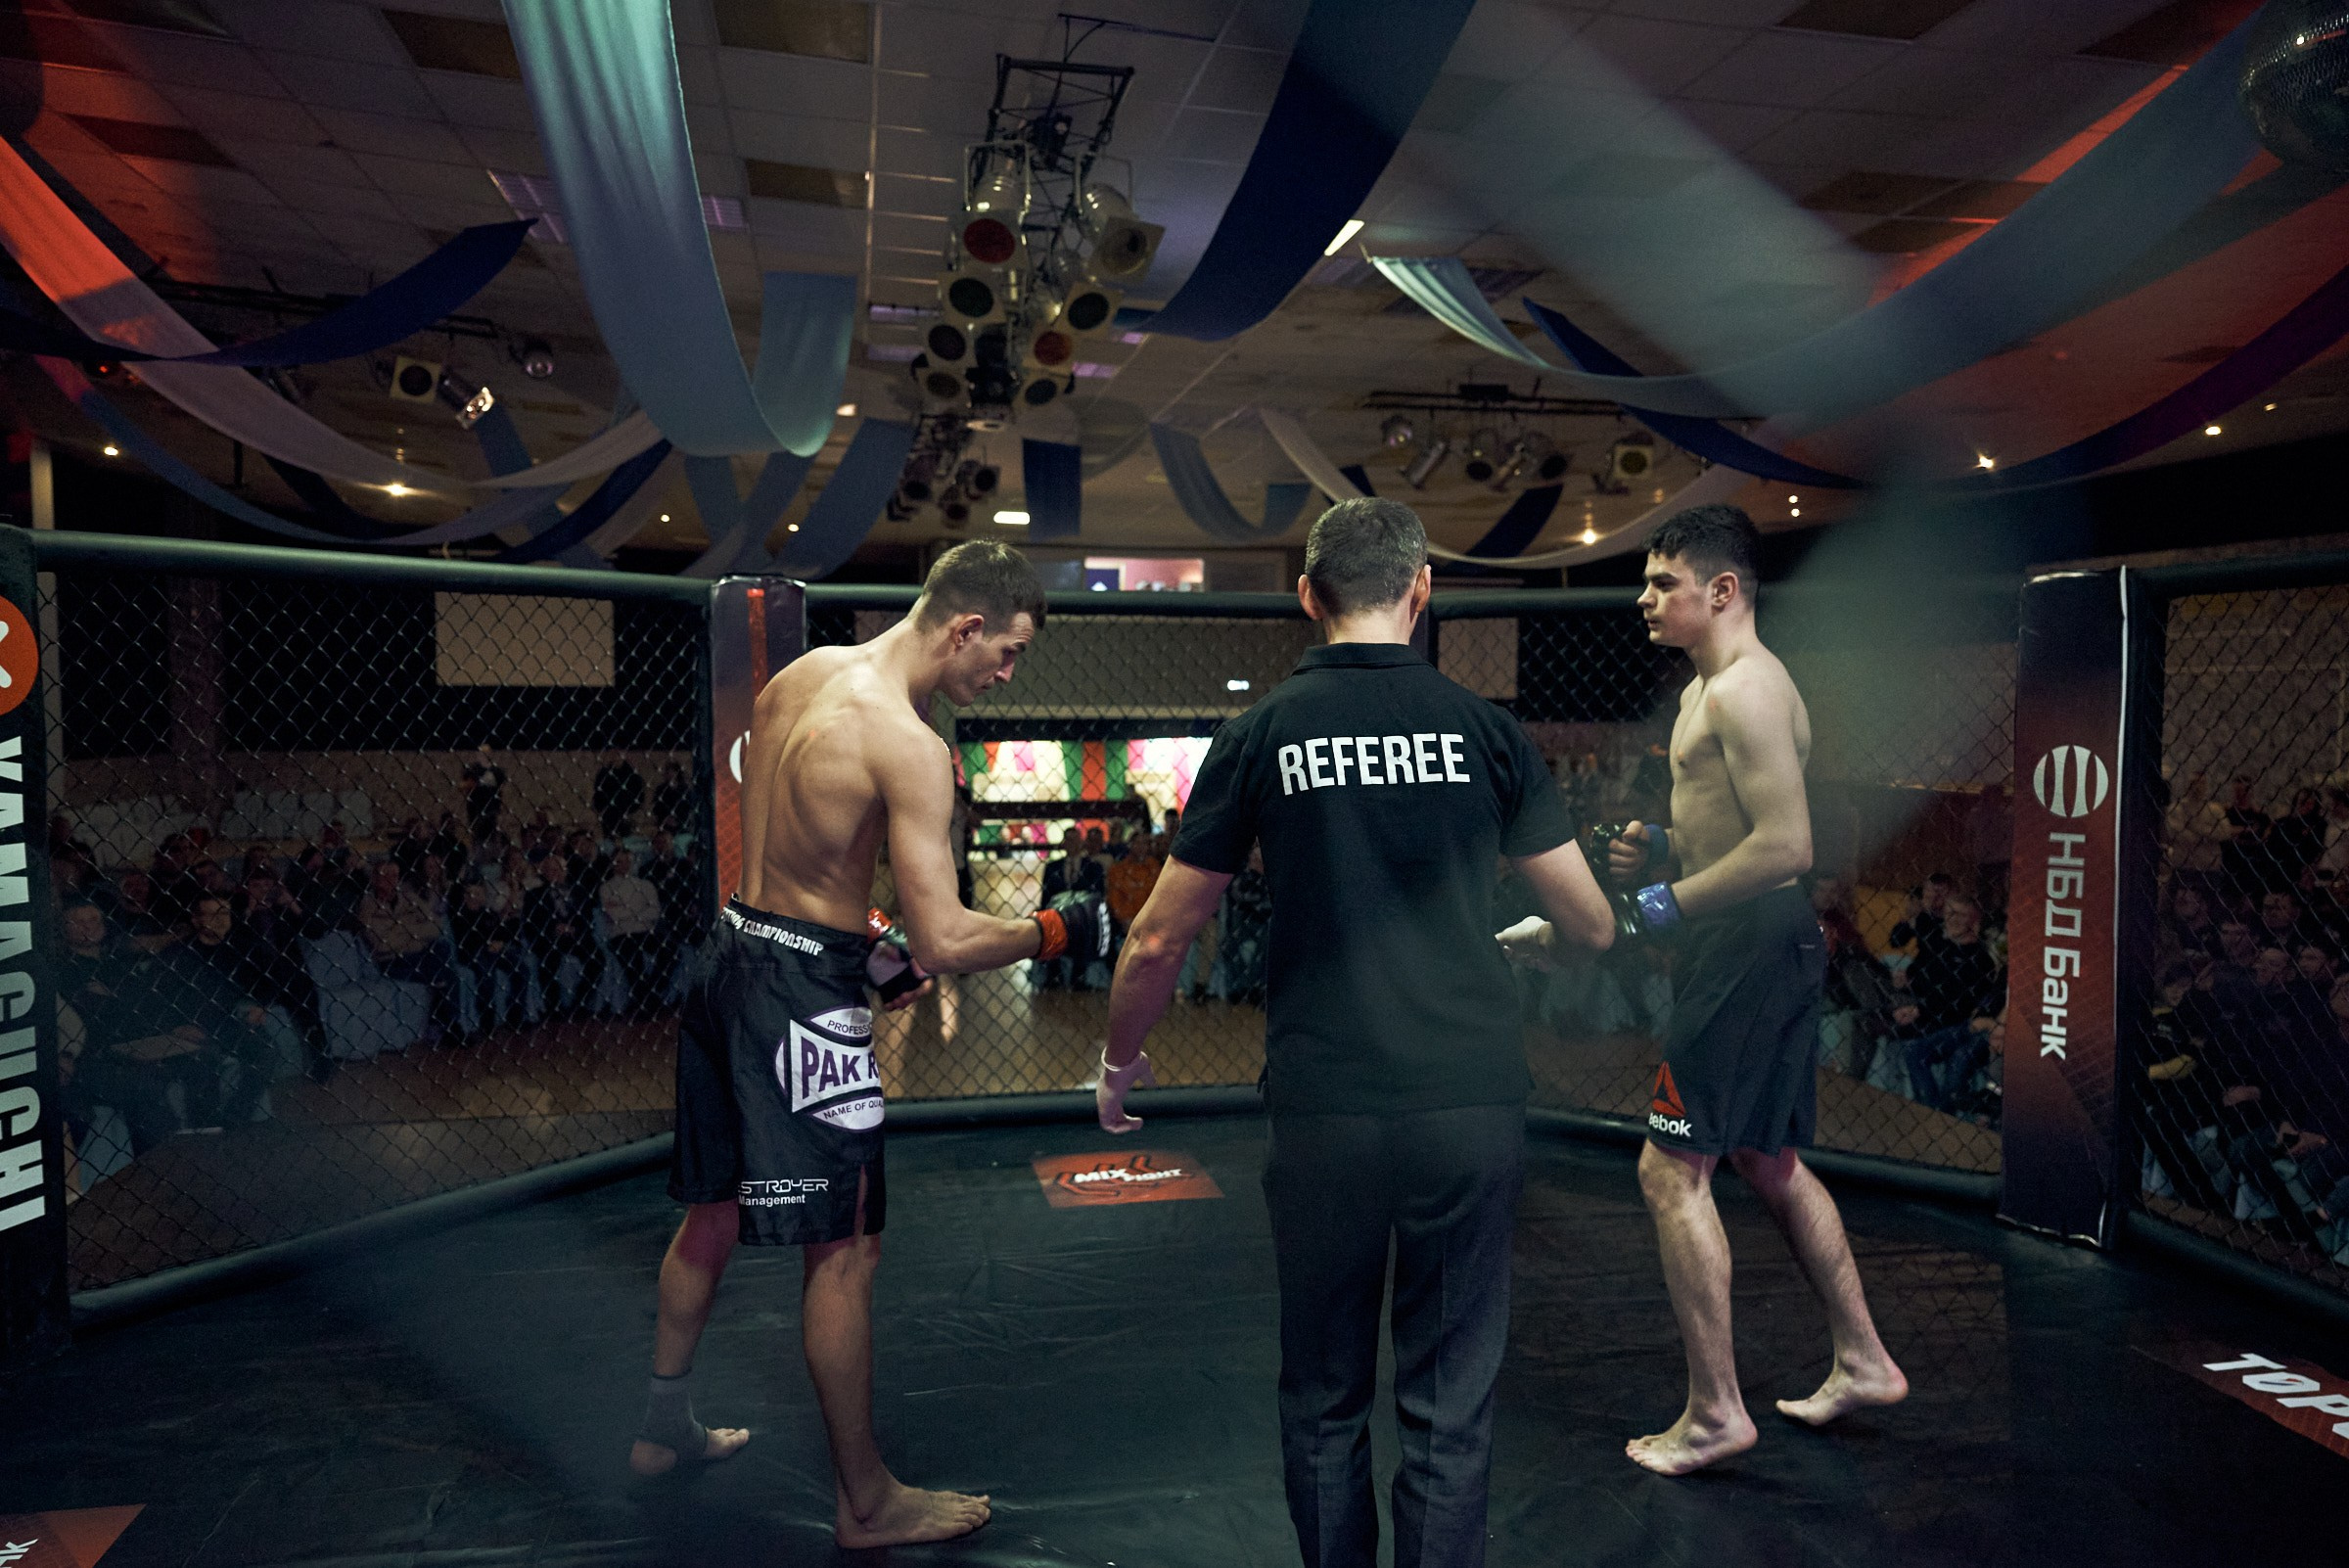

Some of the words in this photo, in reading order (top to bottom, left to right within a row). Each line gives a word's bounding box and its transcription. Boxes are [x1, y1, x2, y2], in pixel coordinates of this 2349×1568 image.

[1278, 733, 1470, 796] REFEREE
[2045, 832, 2085, 938] НБД
[743, 919, 824, 956] CHAMPIONSHIP
[2040, 945, 2081, 1061] Банк
[801, 1036, 861, 1100] PAK
[823, 1105, 852, 1119] NAME
[854, 1101, 866, 1111] OF
[738, 1194, 806, 1207] Management
[2202, 1353, 2349, 1440] TOP
